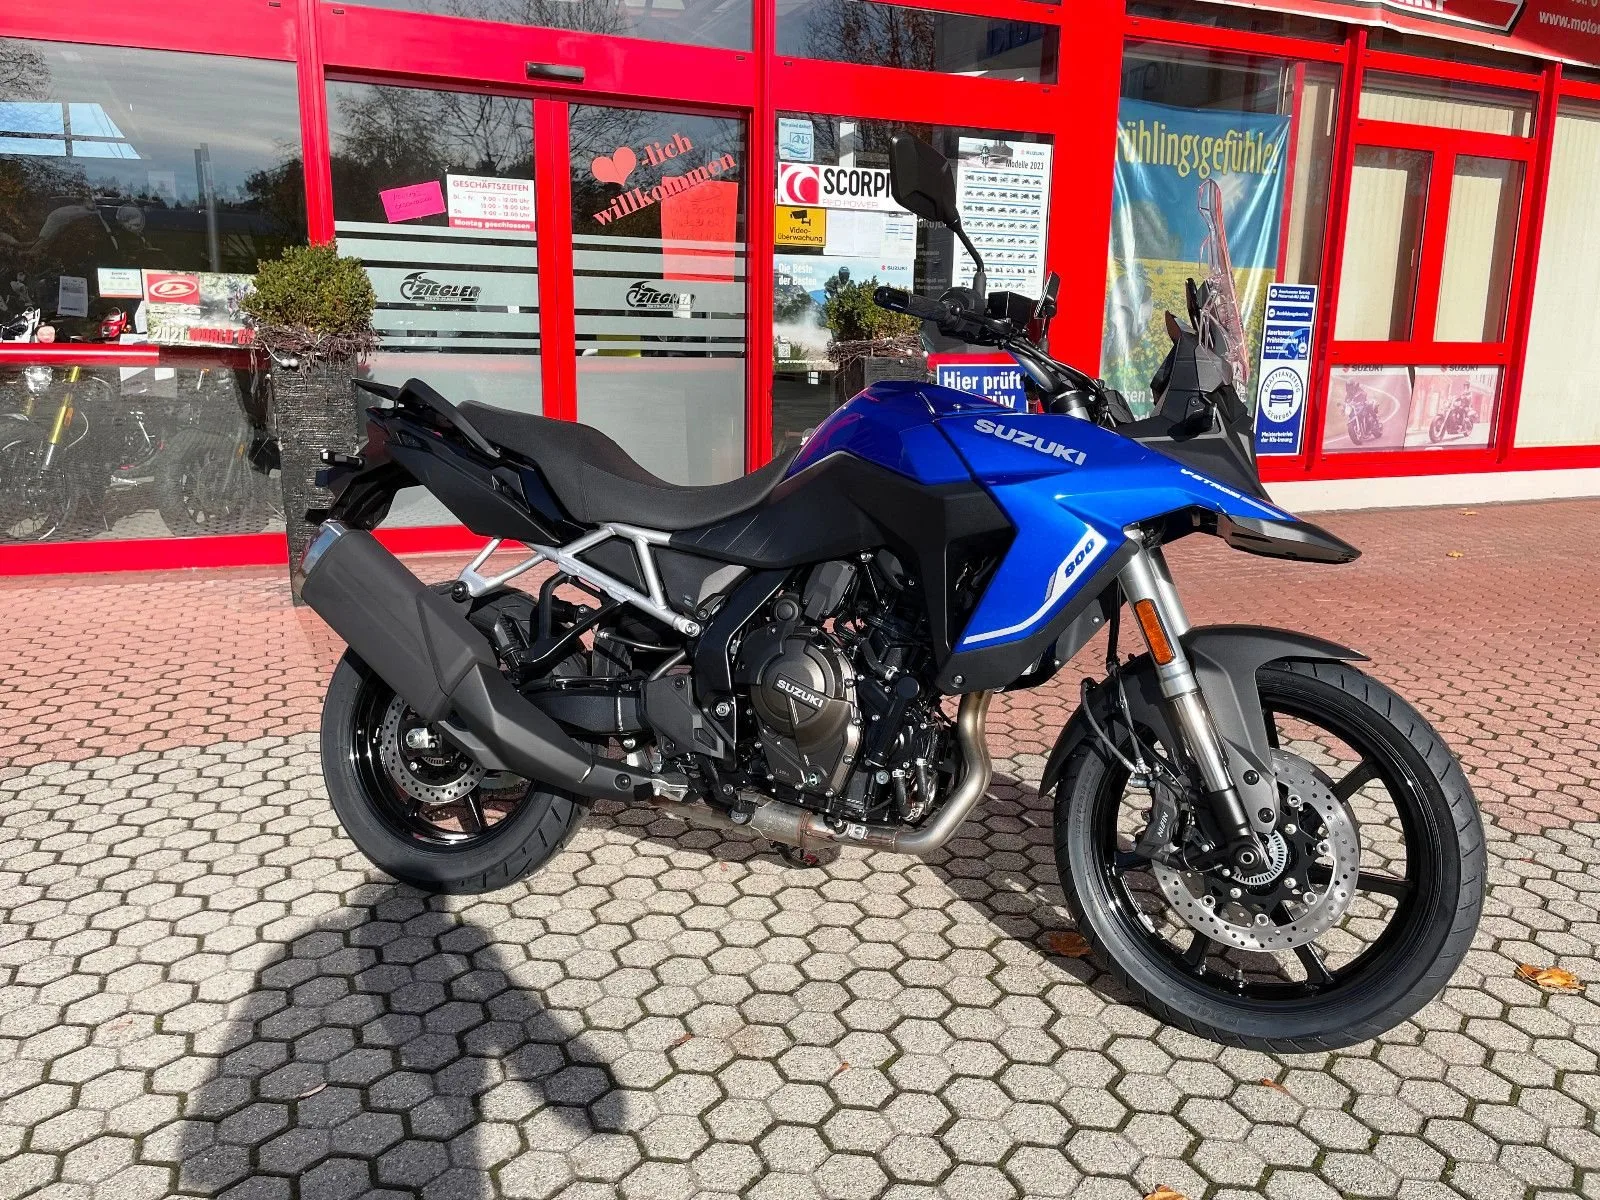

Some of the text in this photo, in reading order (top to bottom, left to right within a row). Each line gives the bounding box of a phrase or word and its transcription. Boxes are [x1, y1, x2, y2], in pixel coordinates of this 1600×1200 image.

[641, 132, 694, 167] -lich
[1005, 159, 1029, 169] Modelle
[1116, 119, 1279, 180] ühlingsgefühle!
[452, 179, 530, 192] GESCHÄFTSZEITEN
[592, 152, 737, 226] willkommen
[823, 168, 891, 199] SCORPI
[411, 283, 481, 298] ZIEGLER
[153, 326, 187, 343] 2021
[943, 371, 1022, 395] Hier prüft
[973, 418, 1088, 467] SUZUKI
[1064, 538, 1096, 579] 800
[776, 679, 824, 708] SUZUKI
